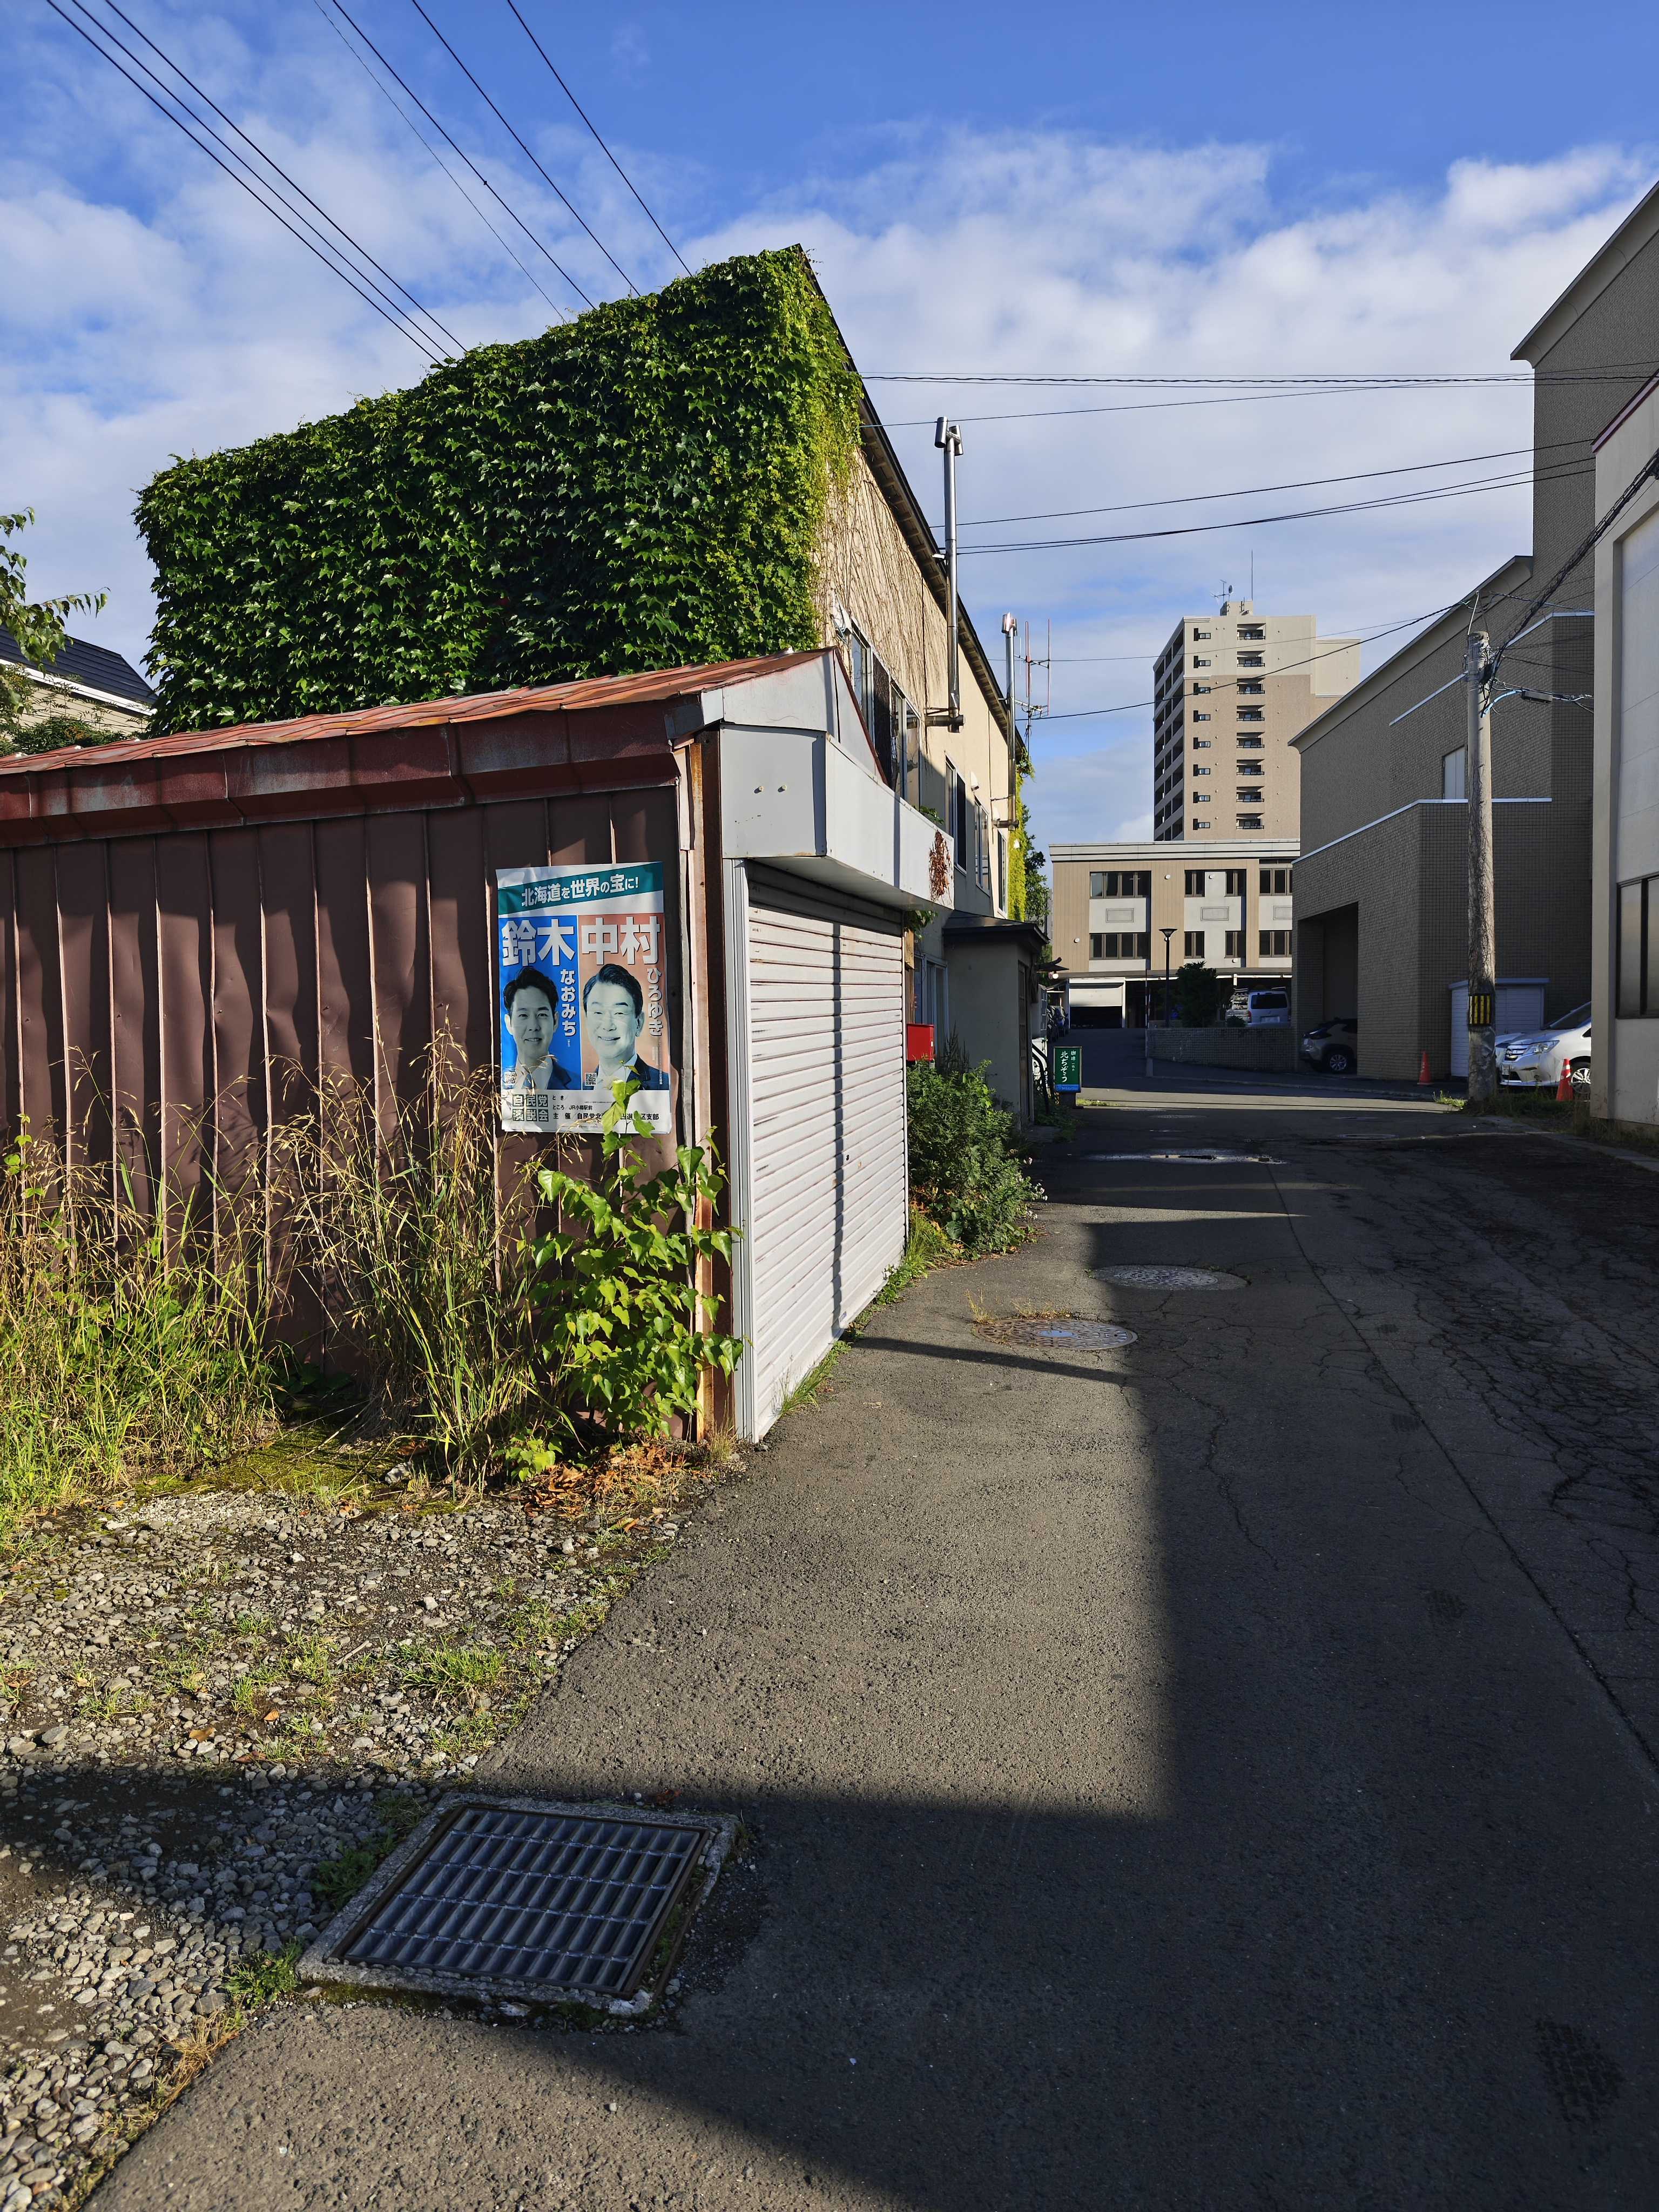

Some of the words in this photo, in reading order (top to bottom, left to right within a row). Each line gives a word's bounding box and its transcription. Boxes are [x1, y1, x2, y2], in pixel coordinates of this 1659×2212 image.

[501, 919, 576, 966] 鈴木
[581, 915, 660, 966] 中村
[560, 969, 576, 1036] なおみち
[647, 967, 663, 1036] ひろゆき
[512, 1095, 548, 1107] 自民党
[512, 1109, 549, 1121] 演説会
